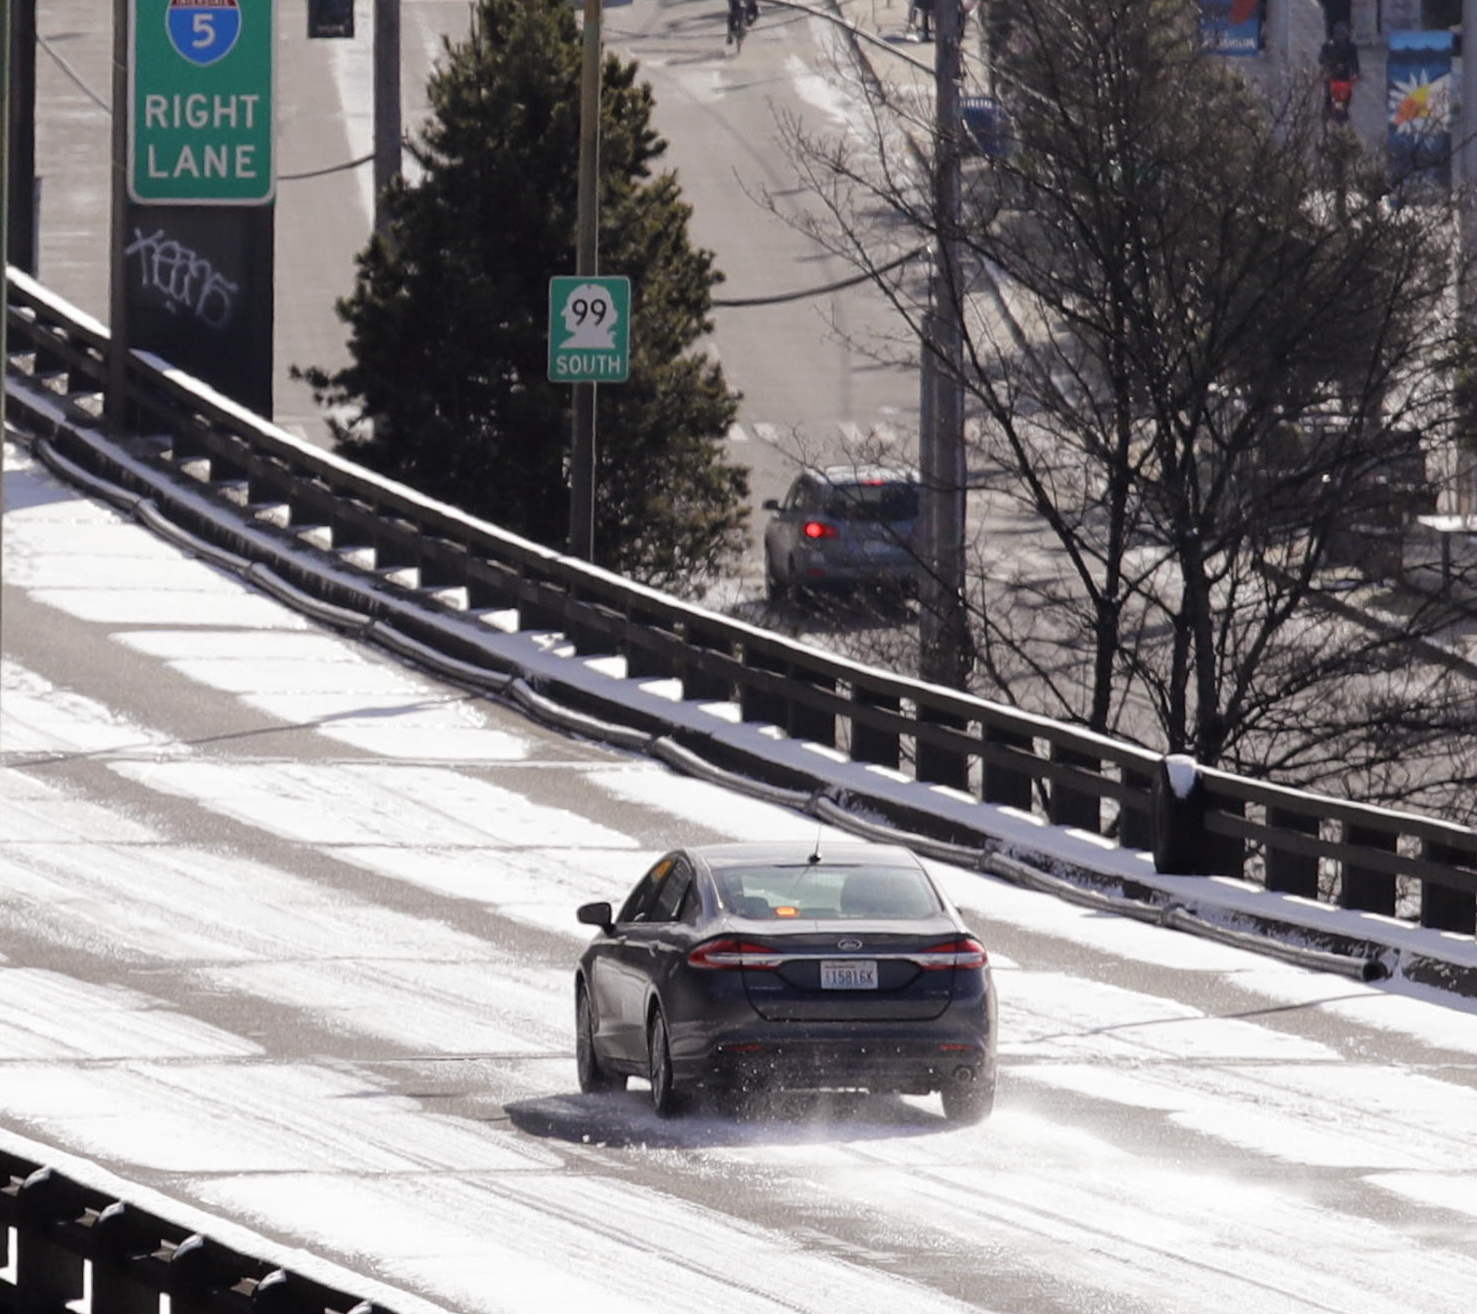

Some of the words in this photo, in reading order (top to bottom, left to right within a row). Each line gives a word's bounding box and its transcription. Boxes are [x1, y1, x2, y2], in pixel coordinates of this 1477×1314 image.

[191, 13, 217, 49] 5
[144, 94, 260, 131] RIGHT
[147, 145, 258, 180] LANE
[571, 298, 607, 327] 99
[556, 355, 621, 375] SOUTH
